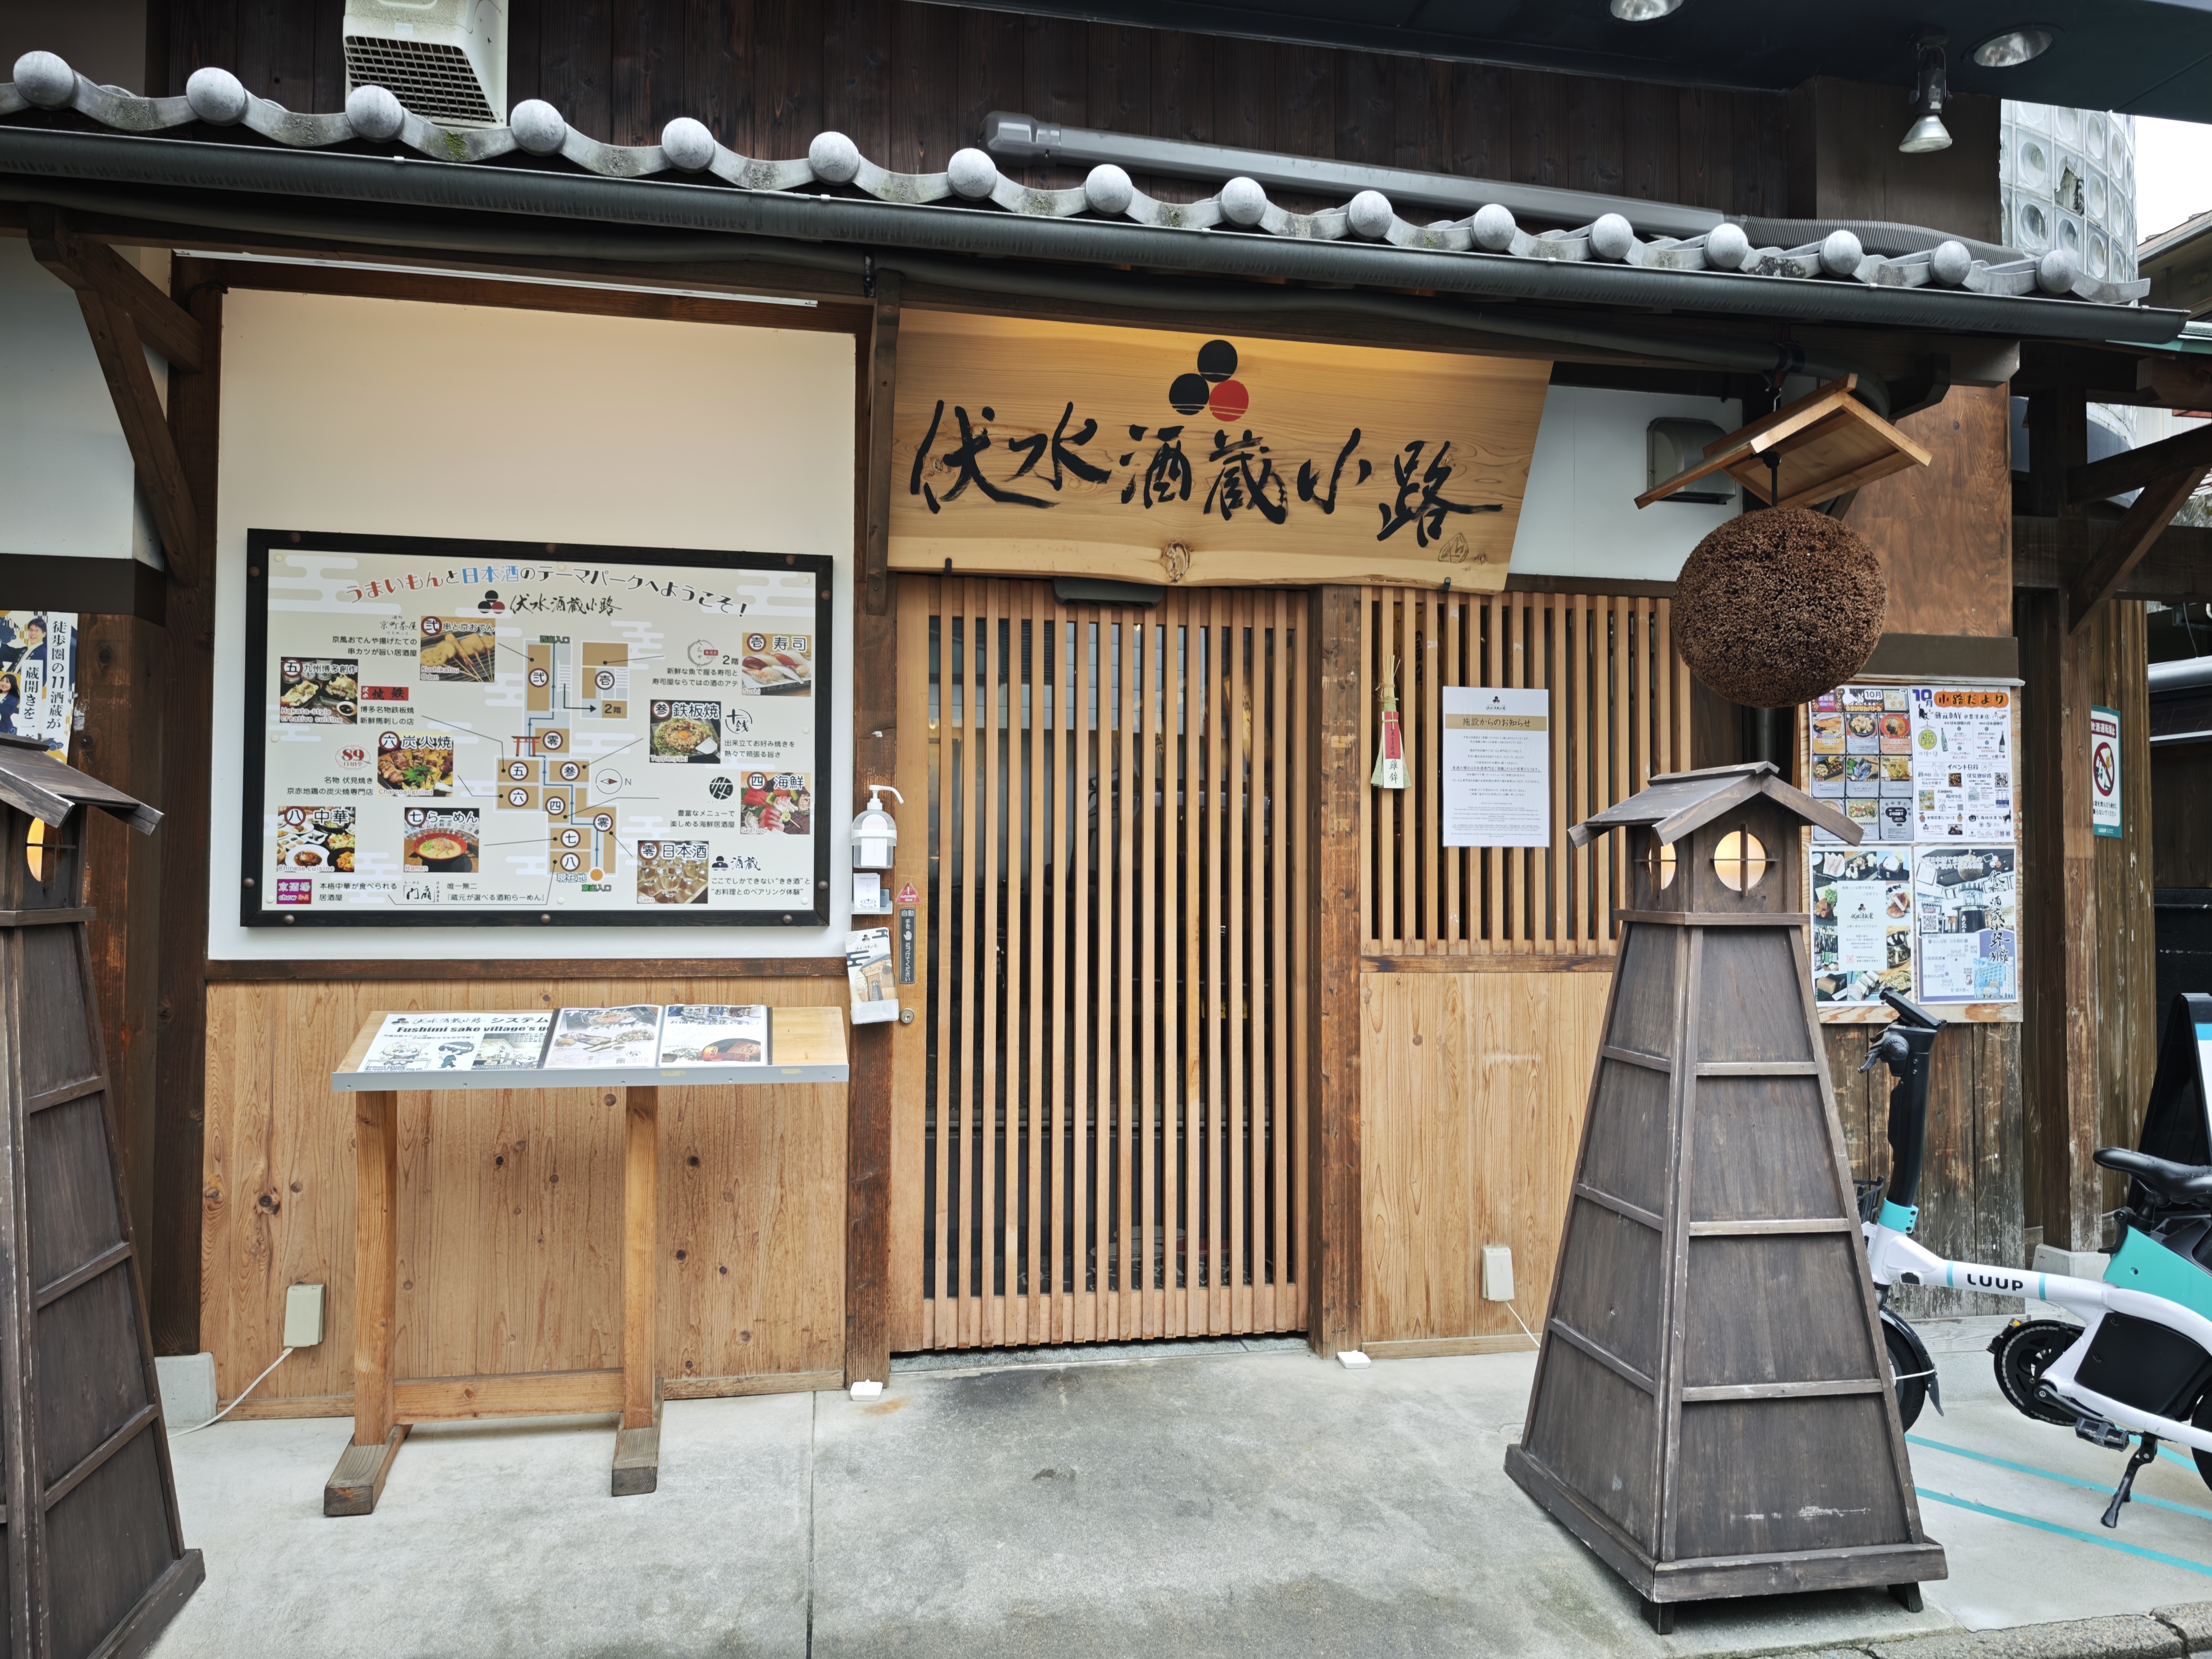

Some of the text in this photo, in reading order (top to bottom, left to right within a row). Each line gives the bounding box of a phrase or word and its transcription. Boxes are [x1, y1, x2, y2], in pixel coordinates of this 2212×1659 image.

[910, 400, 1503, 547] 伏水酒蔵小路
[510, 593, 622, 616] 伏水酒蔵小路
[380, 620, 417, 631] 京町茶屋
[426, 620, 495, 632] 弐 串と京おでん
[332, 636, 417, 645] 京風おでんや揚げたての
[540, 636, 570, 644] 西出入口
[751, 637, 806, 651] 壱 寿司
[348, 648, 417, 657] 串カツが旨い居酒屋
[723, 655, 739, 665] 2階
[287, 662, 358, 674] 五 九州博多創作
[667, 667, 738, 676] 新鮮な魚で握る寿司と
[46, 621, 67, 730] 徒歩圏の11酒蔵が
[599, 675, 611, 685] 壱
[652, 678, 738, 687] 寿司屋ならではの酒のアテ
[21, 667, 39, 738] 蔵開きを一
[1912, 689, 1933, 707] 10月
[1939, 693, 2004, 705] 小路だより
[281, 707, 332, 716] Hakata-style
[360, 706, 414, 714] 博多名物鉄板焼
[604, 704, 622, 714] 2階
[673, 703, 719, 718] 鉄板焼
[1462, 717, 1531, 727] 施設からのお知らせ
[383, 735, 452, 748] 六 炭火焼
[724, 740, 795, 748] 出来立てお好み焼きを
[342, 748, 365, 761] 89
[513, 766, 524, 776] 五
[625, 778, 632, 786] N
[751, 775, 804, 790] 四 海鮮
[287, 787, 373, 795] 京赤地鶏の炭火焼専門店
[512, 792, 524, 802] 六
[550, 801, 561, 810] 四
[2093, 800, 2117, 809] 酒を飲んだら絶対に
[288, 810, 348, 824] 八 中華
[409, 811, 477, 823] 七 らーめん
[670, 820, 735, 828] 楽しめる海鮮居酒屋
[565, 833, 576, 844] 七
[662, 844, 707, 859] 日本酒
[564, 857, 576, 867] 八
[731, 856, 761, 871] 酒蔵
[556, 873, 587, 882] 現在地
[278, 882, 311, 892] 京酒場
[905, 919, 911, 929] 手を
[1966, 1273, 2024, 1291] LUUP
